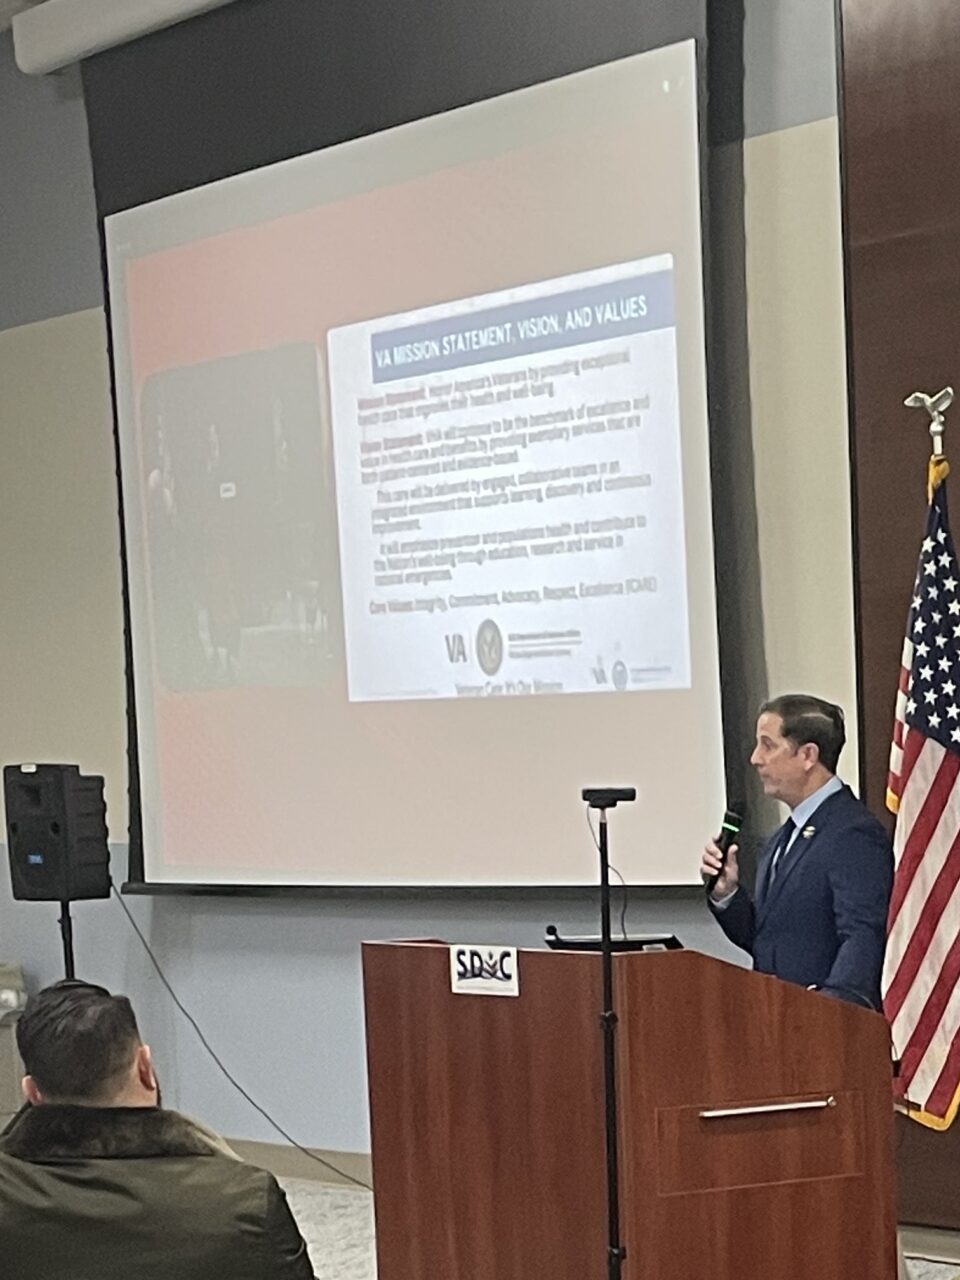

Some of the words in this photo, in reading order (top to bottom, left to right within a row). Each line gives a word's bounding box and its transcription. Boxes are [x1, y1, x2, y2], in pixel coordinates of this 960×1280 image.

[374, 348, 392, 368] VA
[393, 339, 440, 366] MISSION
[565, 306, 592, 331] AND
[595, 294, 648, 324] VALUES
[444, 633, 467, 663] VA
